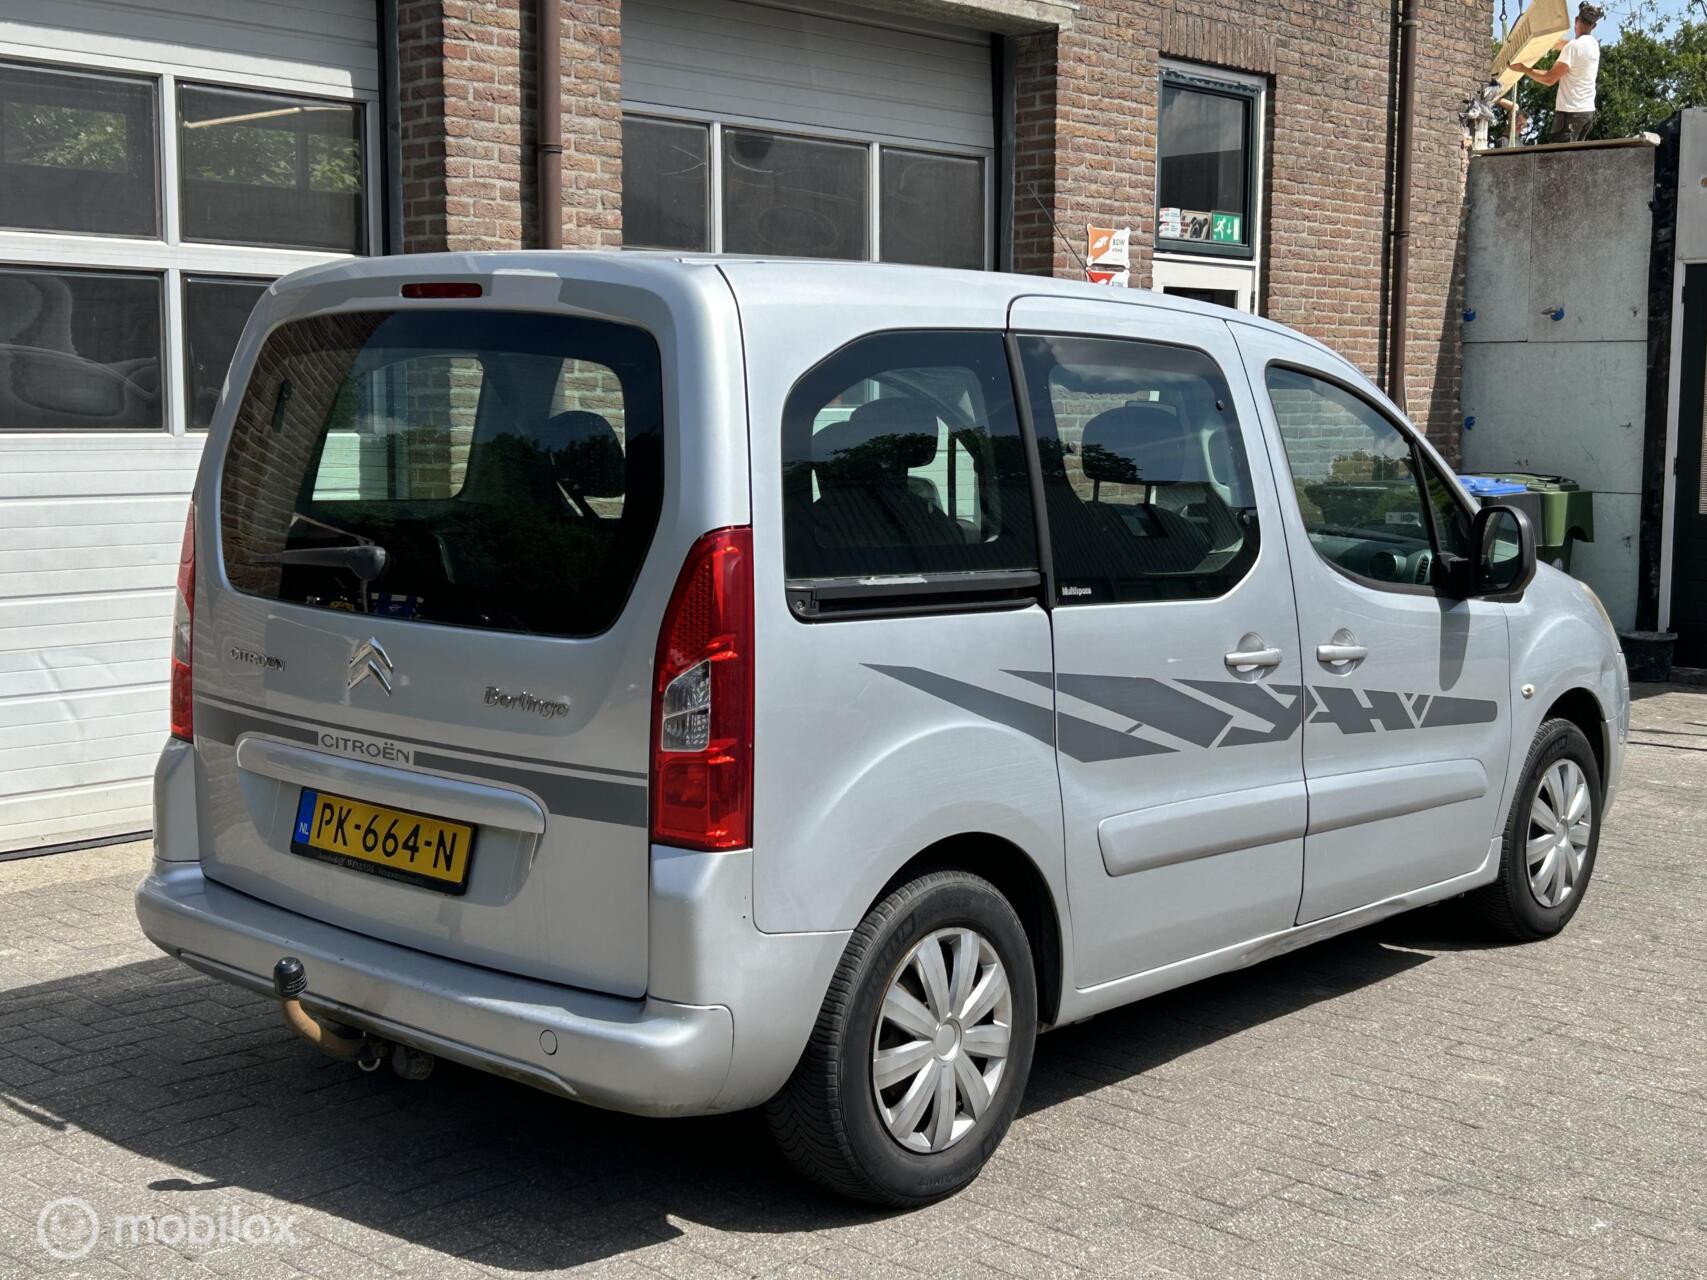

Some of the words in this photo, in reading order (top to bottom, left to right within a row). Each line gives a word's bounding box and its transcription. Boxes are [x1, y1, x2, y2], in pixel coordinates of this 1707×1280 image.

[484, 686, 569, 719] Berlingo
[321, 733, 410, 764] CITROËN
[299, 821, 310, 836] NL
[316, 802, 457, 872] PK-664-N
